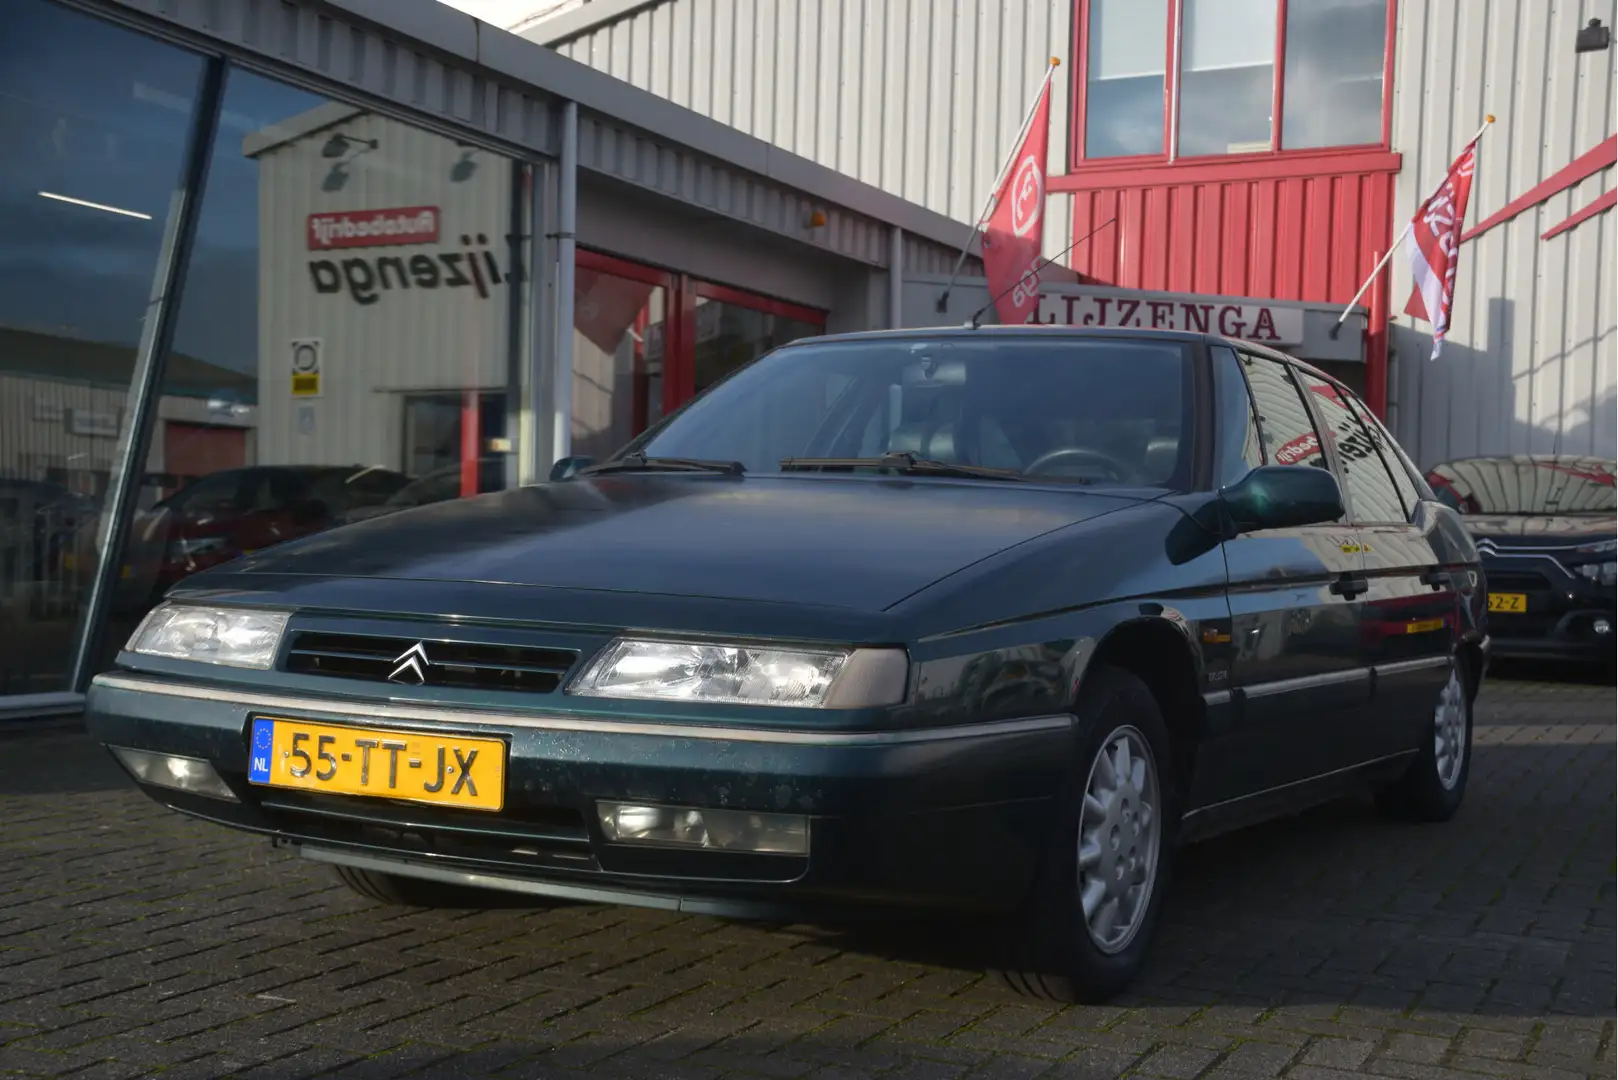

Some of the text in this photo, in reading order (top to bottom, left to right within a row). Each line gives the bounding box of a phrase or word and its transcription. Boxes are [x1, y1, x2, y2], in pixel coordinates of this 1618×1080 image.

[1027, 294, 1281, 340] LIJZENGA
[254, 756, 269, 772] NL
[290, 732, 478, 796] 55-TT-JX
